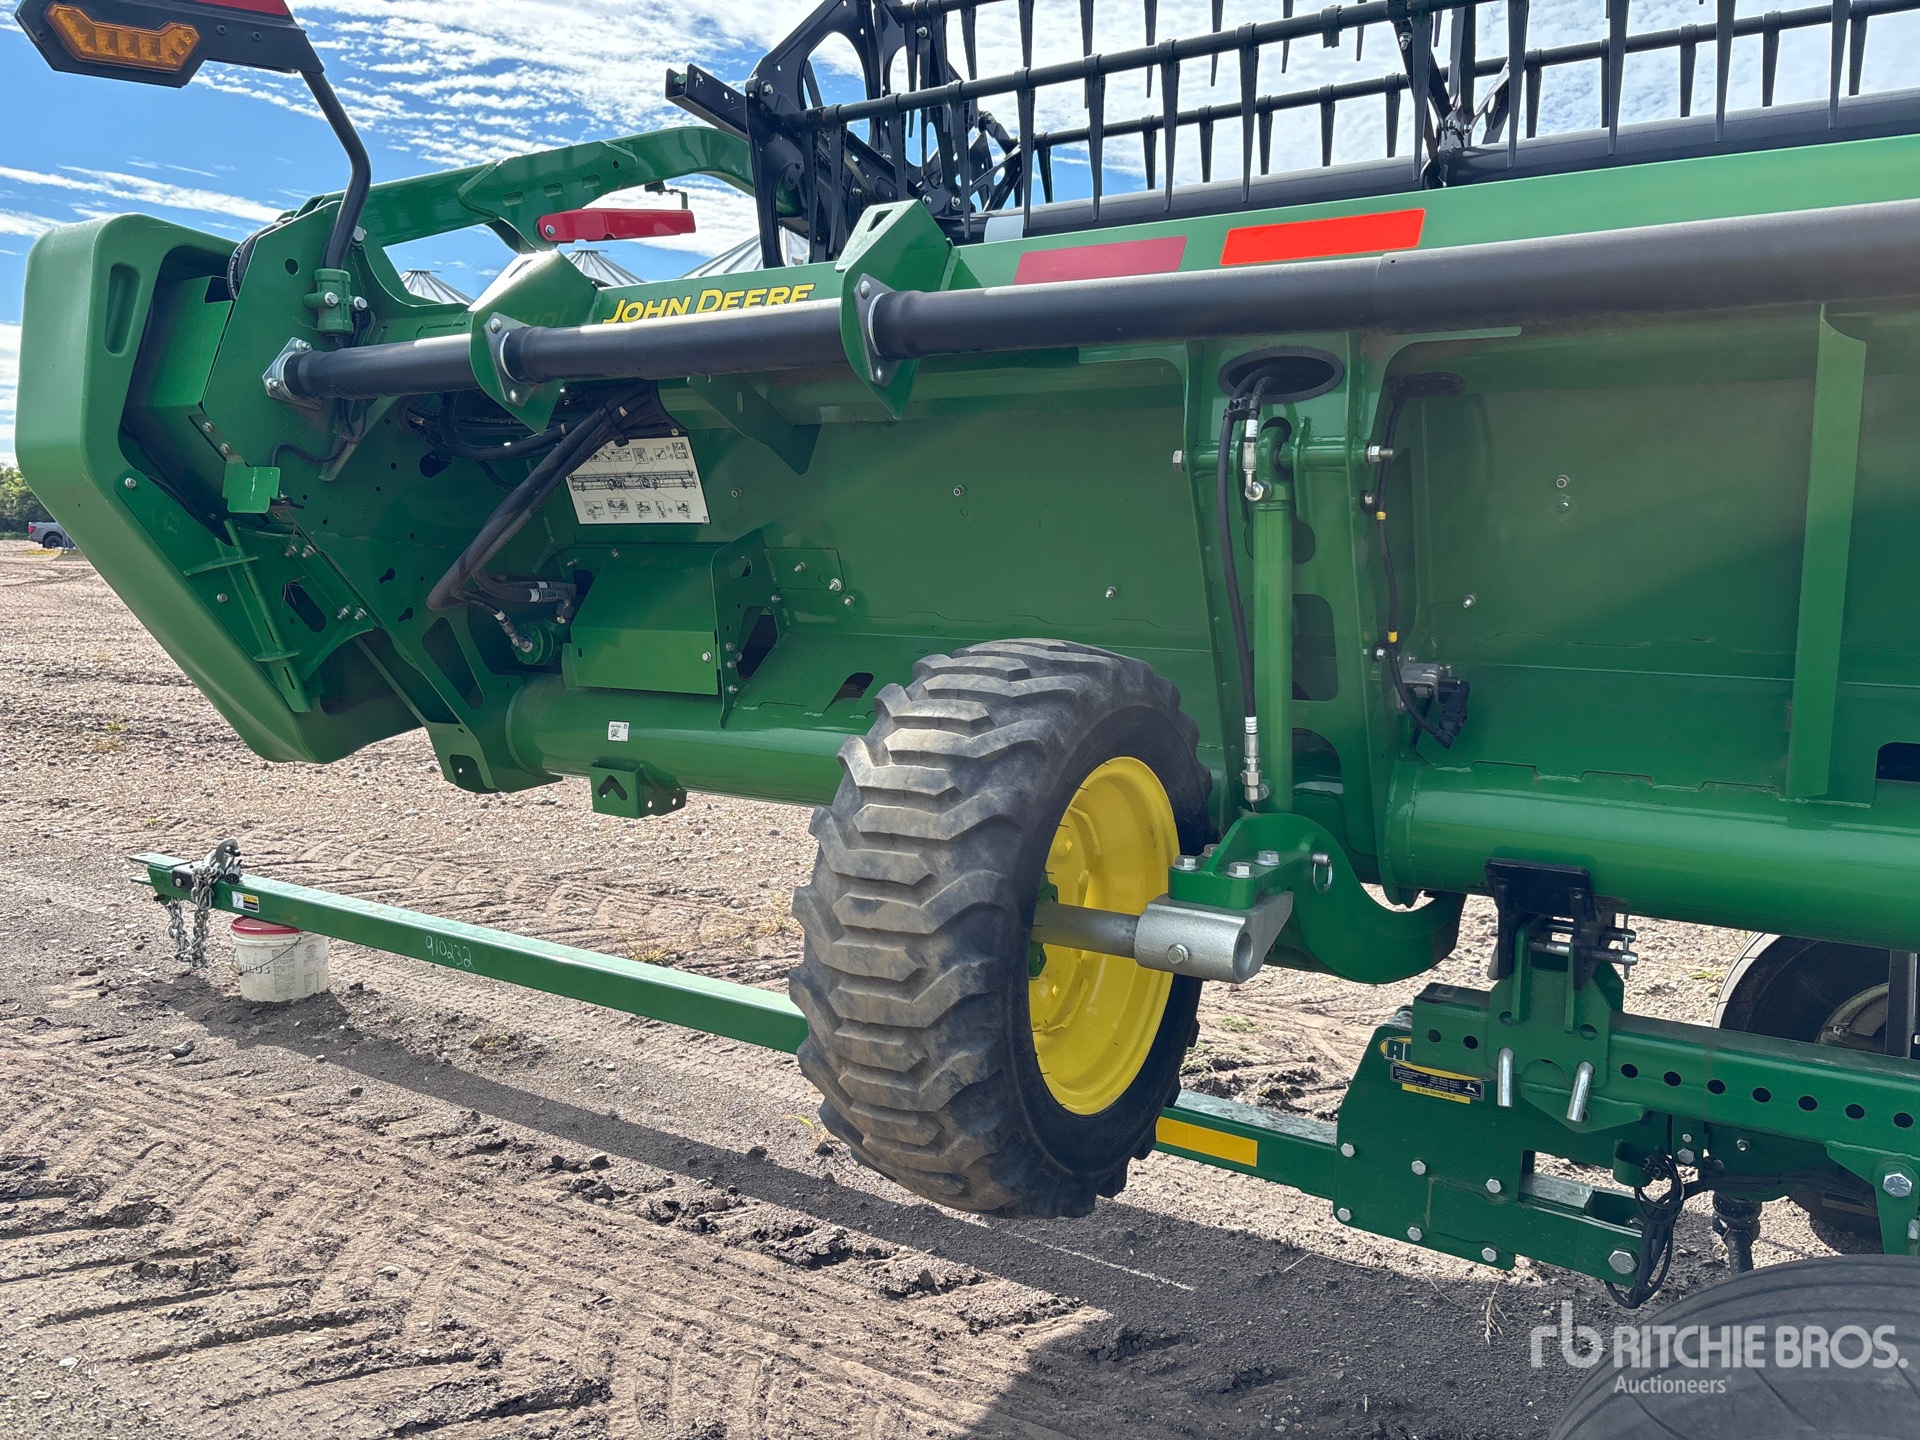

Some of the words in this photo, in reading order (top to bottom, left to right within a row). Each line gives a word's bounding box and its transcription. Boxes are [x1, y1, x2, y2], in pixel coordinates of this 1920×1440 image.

[602, 296, 692, 324] JOHN
[695, 283, 816, 314] DEERE
[426, 935, 476, 971] 910232
